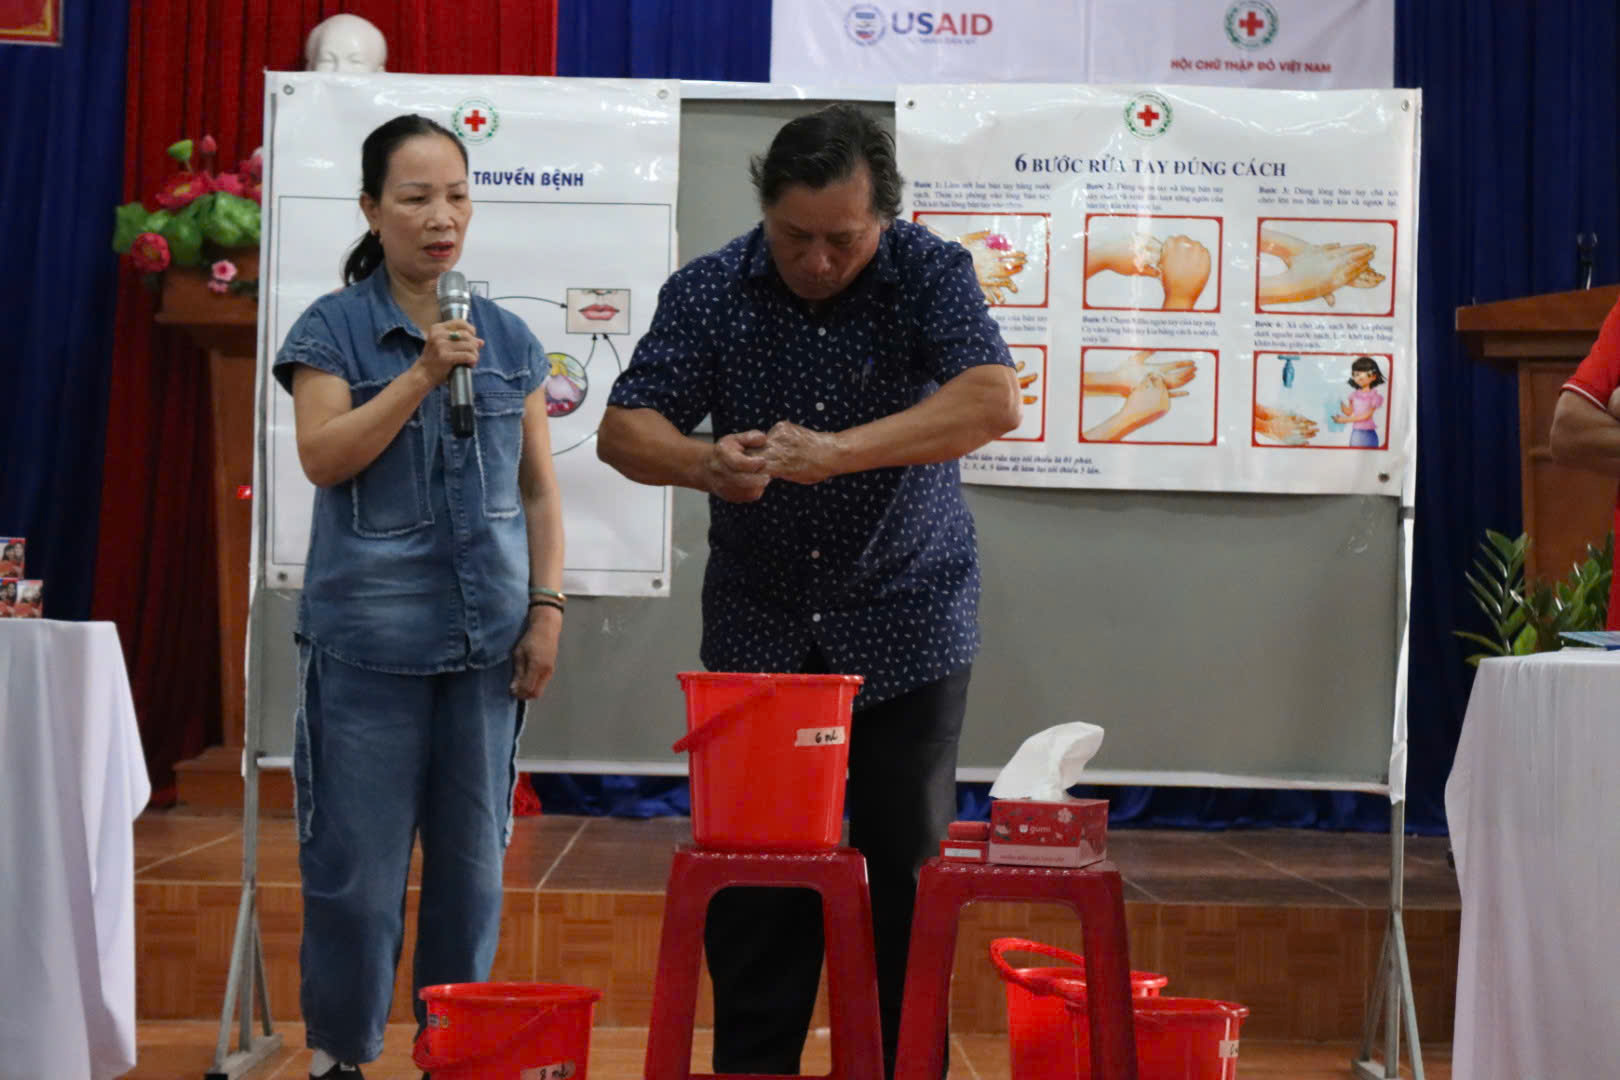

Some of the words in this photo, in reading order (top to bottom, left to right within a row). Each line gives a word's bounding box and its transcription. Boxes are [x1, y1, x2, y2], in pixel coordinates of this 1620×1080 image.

[891, 11, 994, 36] USAID
[1279, 59, 1301, 74] VIỆT
[1304, 61, 1332, 73] NAM
[1014, 153, 1027, 173] 6
[1032, 154, 1083, 174] BƯỚC
[1132, 158, 1169, 175] TAY
[1174, 156, 1226, 175] ĐÚNG
[1232, 156, 1286, 177] CÁCH
[541, 169, 584, 191] BỆNH
[815, 731, 822, 744] 6
